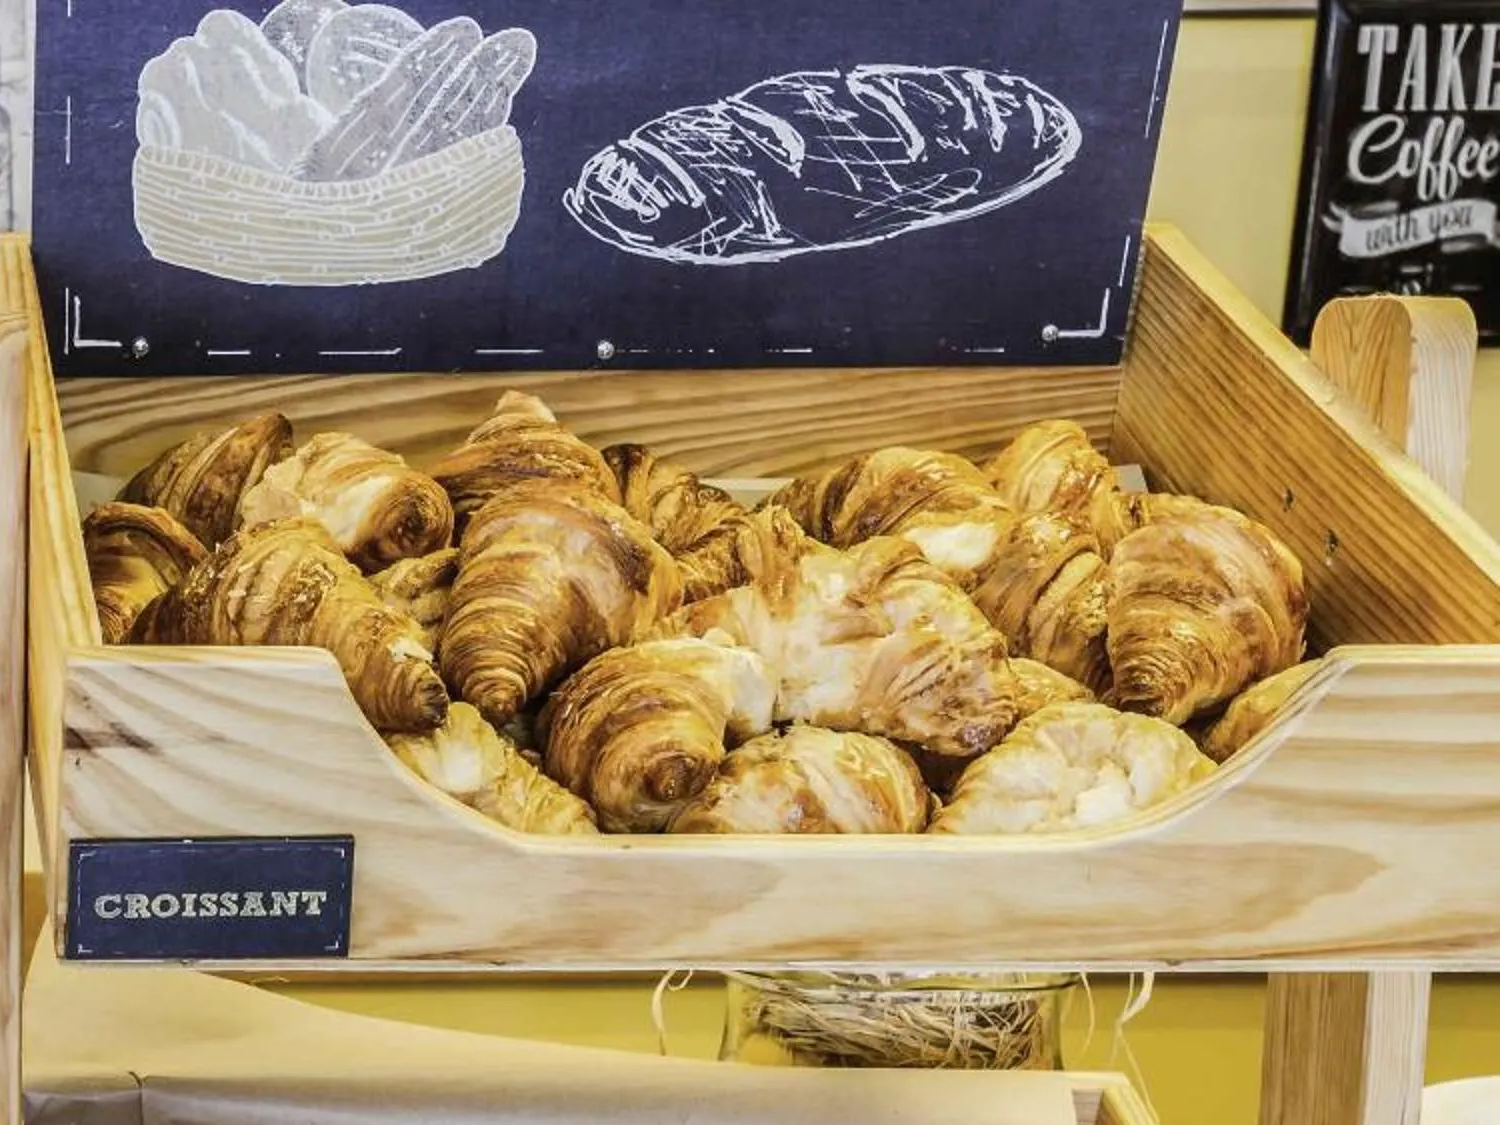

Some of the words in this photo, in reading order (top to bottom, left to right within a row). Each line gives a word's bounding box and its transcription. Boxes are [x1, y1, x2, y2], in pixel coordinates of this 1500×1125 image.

[1357, 24, 1500, 112] TAKE
[1347, 114, 1500, 201] Coffee
[1366, 213, 1420, 250] with
[1429, 206, 1473, 240] you
[94, 891, 327, 920] CROISSANT
